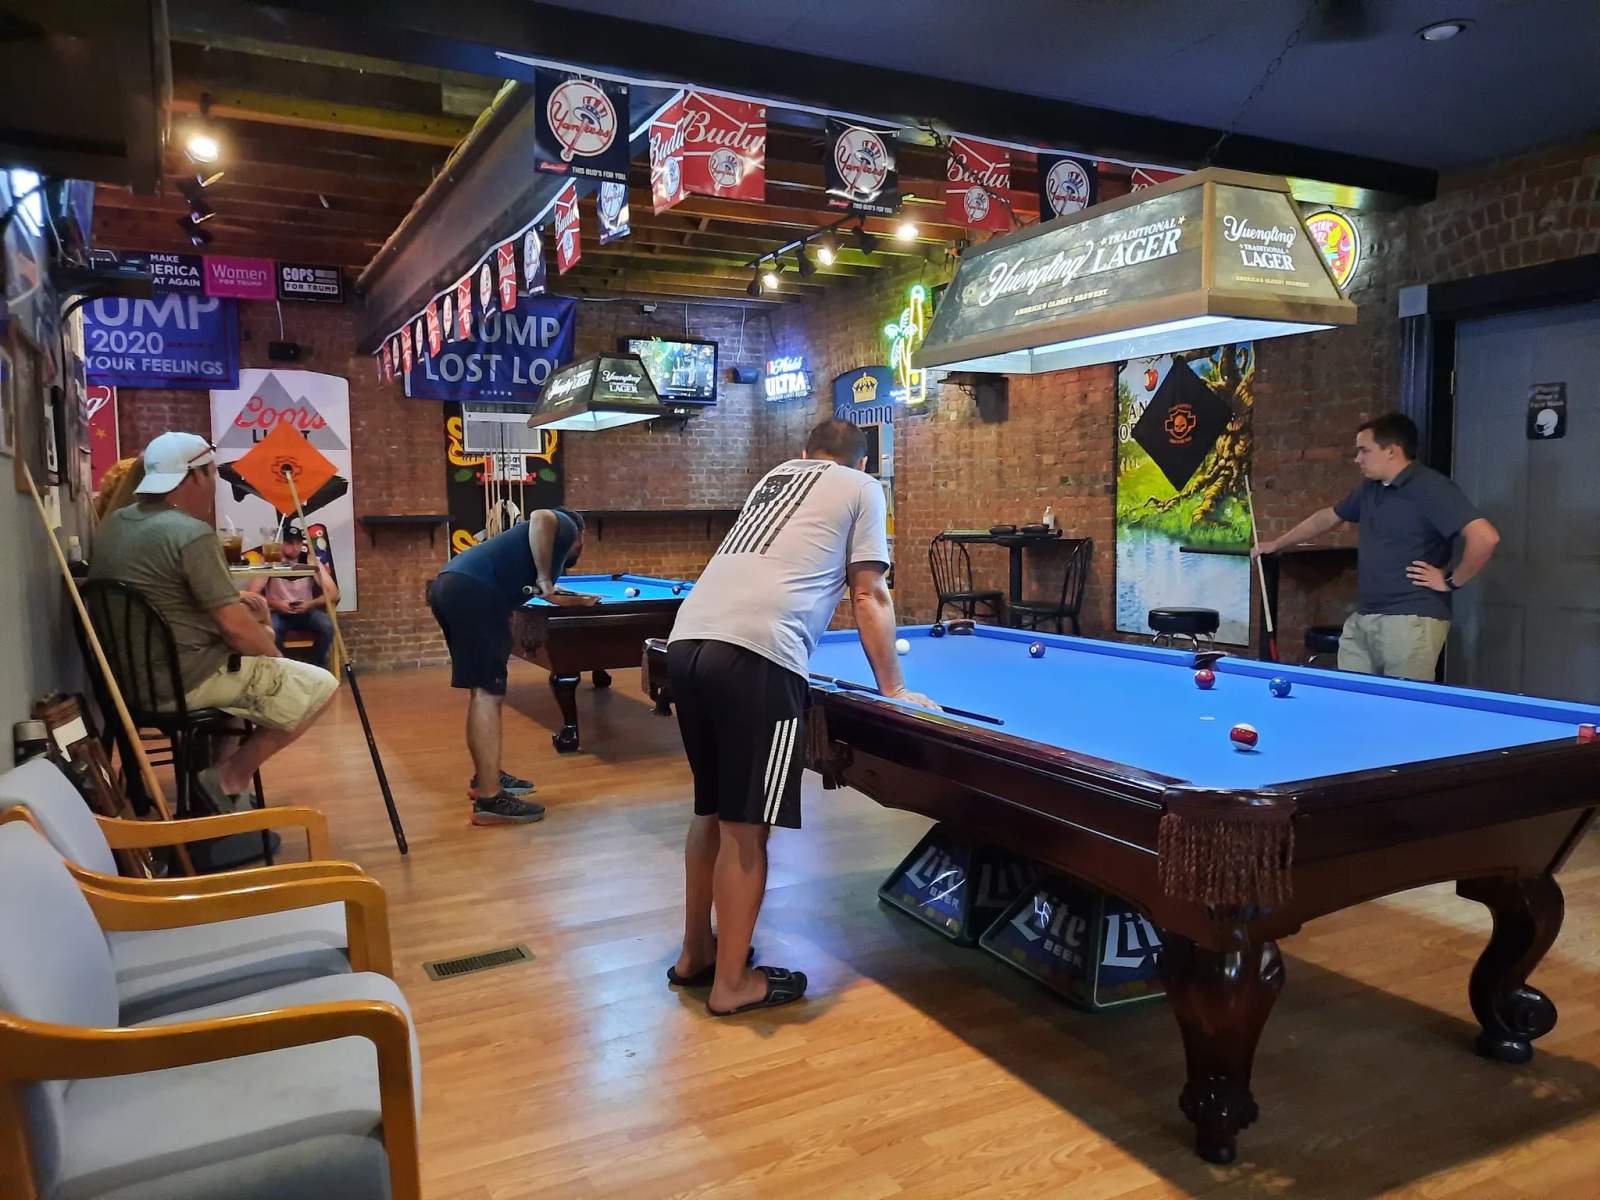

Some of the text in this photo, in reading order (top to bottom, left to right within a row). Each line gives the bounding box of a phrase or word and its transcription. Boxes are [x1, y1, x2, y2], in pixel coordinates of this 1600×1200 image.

[1107, 217, 1177, 245] TRADITIONAL
[1223, 215, 1297, 248] Yuengling
[150, 254, 180, 263] MAKE
[1240, 250, 1296, 271] LAGER
[1243, 244, 1286, 255] TRADITIONAL
[212, 264, 268, 280] Women
[283, 267, 315, 281] COPS
[978, 228, 1182, 307] Yuengling LAGER
[168, 279, 201, 287] AGAIN
[308, 284, 338, 293] TRUMP
[83, 292, 220, 329] UMP
[91, 329, 164, 354] 2020
[86, 356, 224, 375] YOUR FEELINGS
[424, 352, 502, 382] LOST
[609, 384, 639, 394] LAGER
[765, 371, 806, 397] ULTRA
[234, 396, 327, 429] Coors
[835, 402, 893, 424] Corona
[252, 428, 311, 444] LIT
[928, 886, 960, 909] BEER
[1102, 912, 1163, 969] Lit
[1043, 939, 1083, 966] BEER
